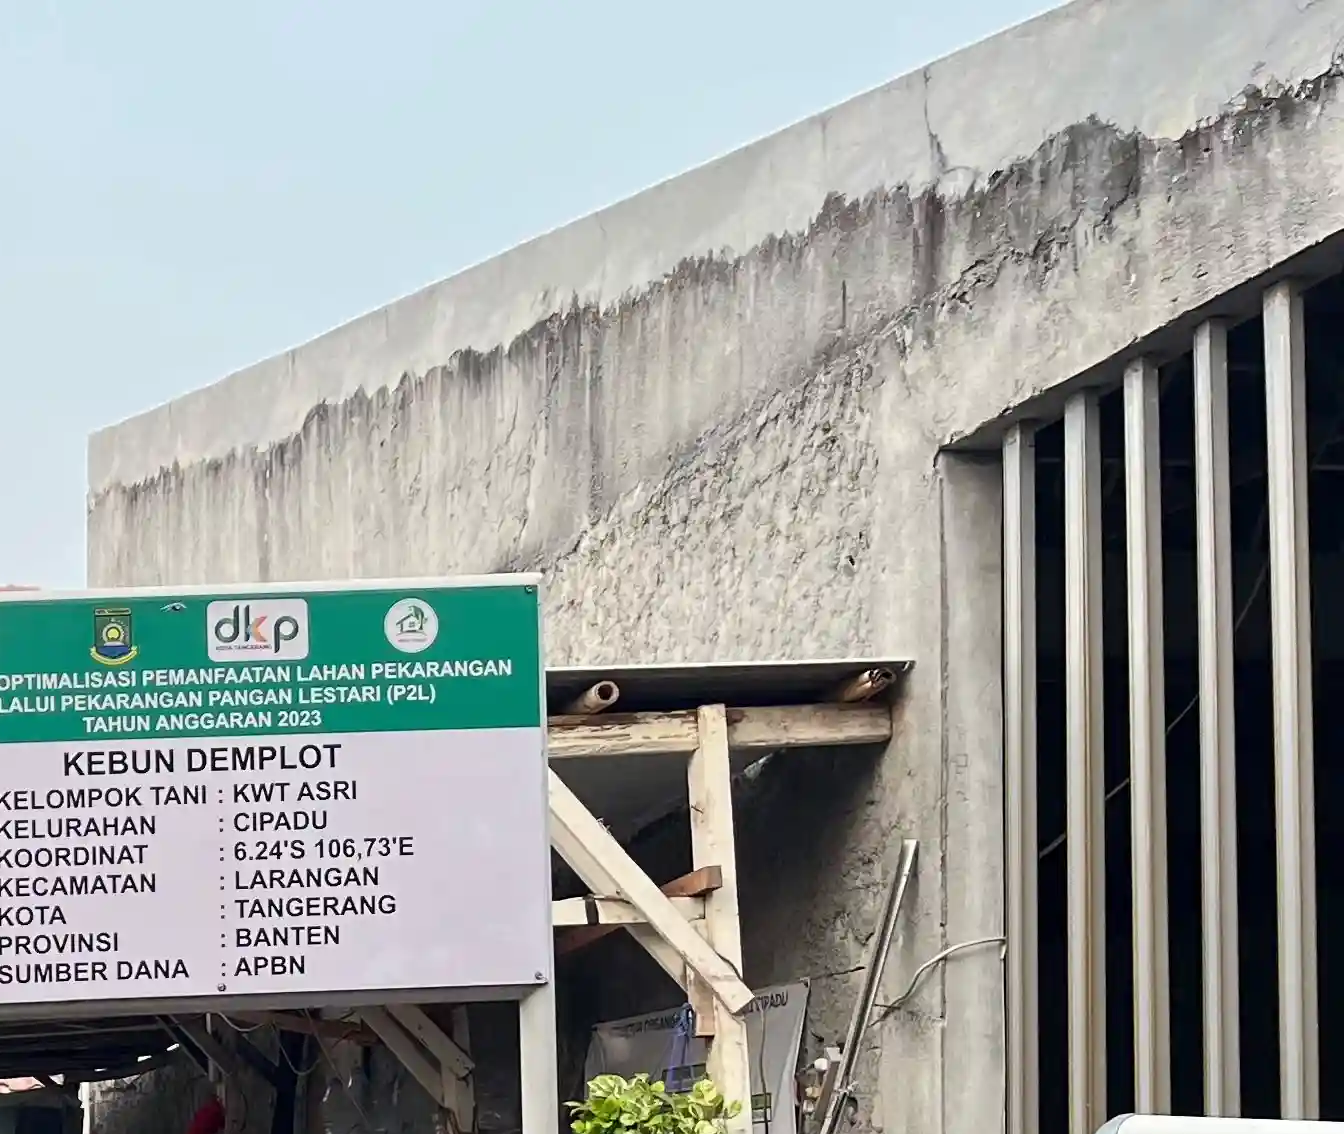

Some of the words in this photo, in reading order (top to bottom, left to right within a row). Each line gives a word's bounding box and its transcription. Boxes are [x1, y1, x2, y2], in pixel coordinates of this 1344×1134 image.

[215, 605, 299, 653] dkp
[142, 665, 291, 687] PEMANFAATAN
[296, 663, 365, 682] LAHAN
[371, 659, 512, 680] PEKARANGAN
[61, 690, 203, 711] PEKARANGAN
[208, 688, 292, 707] PANGAN
[298, 685, 381, 704] LESTARI
[386, 683, 436, 705] (P2L)
[82, 715, 150, 733] TAHUN
[155, 711, 272, 731] ANGGARAN
[277, 709, 322, 727] 2023
[63, 748, 175, 777] KEBUN
[186, 743, 342, 773] DEMPLOT
[149, 784, 207, 806] TANI
[233, 782, 291, 804] KWT
[296, 780, 357, 802] ASRI
[233, 810, 327, 832] CIPADU
[235, 866, 379, 890] LARANGAN
[234, 894, 396, 919] TANGERANG
[235, 925, 340, 948] BANTEN
[116, 958, 190, 981] DANA
[233, 955, 305, 977] APBN
